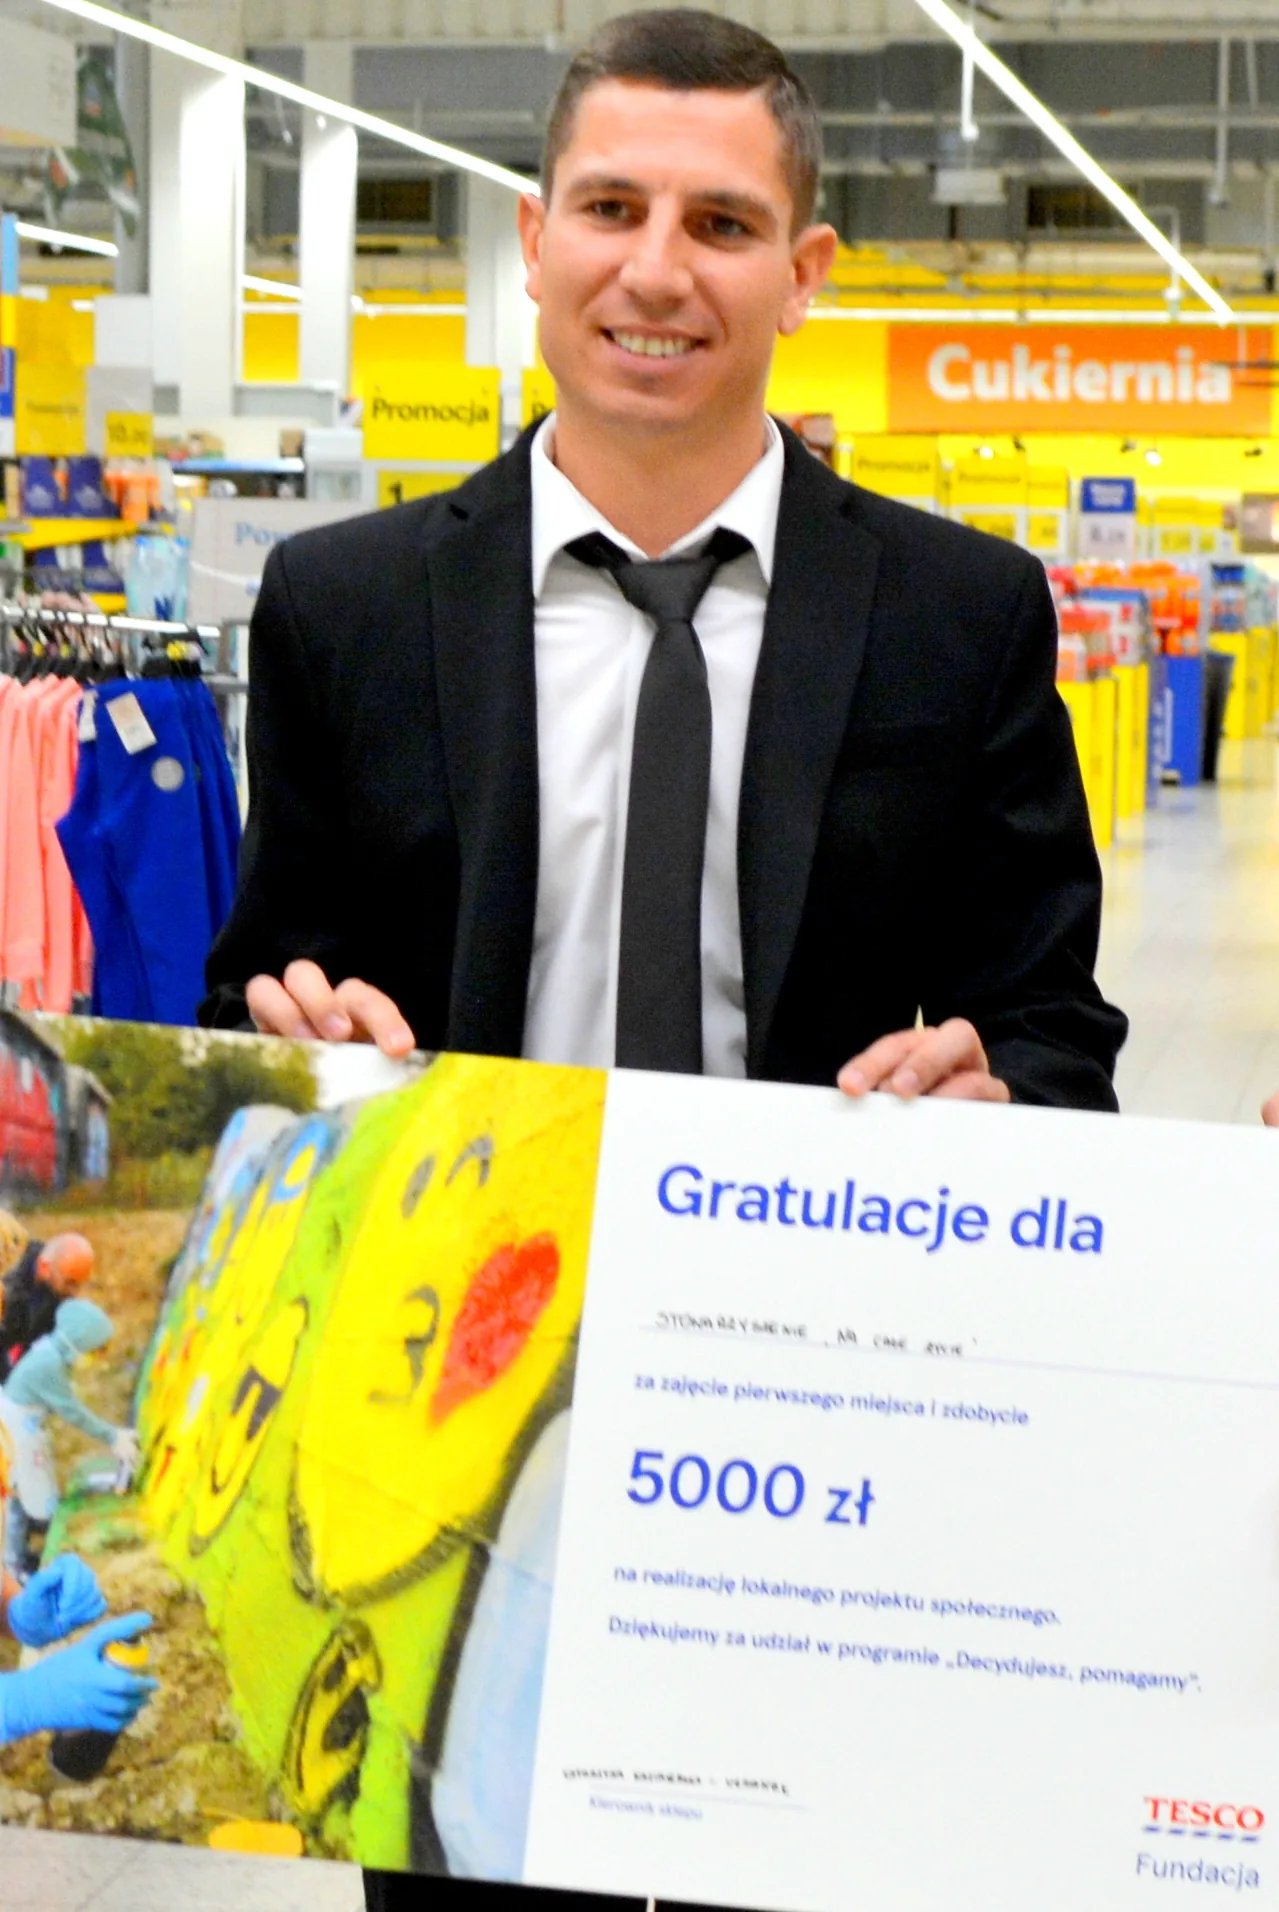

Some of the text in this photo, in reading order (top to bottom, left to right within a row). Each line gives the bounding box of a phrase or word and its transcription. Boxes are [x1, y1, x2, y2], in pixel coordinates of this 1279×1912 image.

[927, 342, 1232, 403] Cukiernia
[372, 398, 490, 426] Promocja
[657, 1163, 1104, 1254] Gratulacje dla
[634, 1374, 655, 1390] za
[661, 1373, 729, 1398] zajęcie
[733, 1381, 845, 1411] pierwszego
[850, 1393, 925, 1418] miejsca
[942, 1401, 1030, 1427] zdobycie
[626, 1447, 876, 1527] 5000 zł
[613, 1565, 1062, 1628] na realizację lokalnego projektu społecznego.
[608, 1614, 720, 1649] Dziękujemy
[725, 1630, 746, 1646] za
[751, 1631, 811, 1653] udział
[816, 1638, 833, 1655] w
[837, 1640, 941, 1664] programie
[1143, 1796, 1266, 1832] TESCO
[1136, 1852, 1261, 1892] Fundacja
